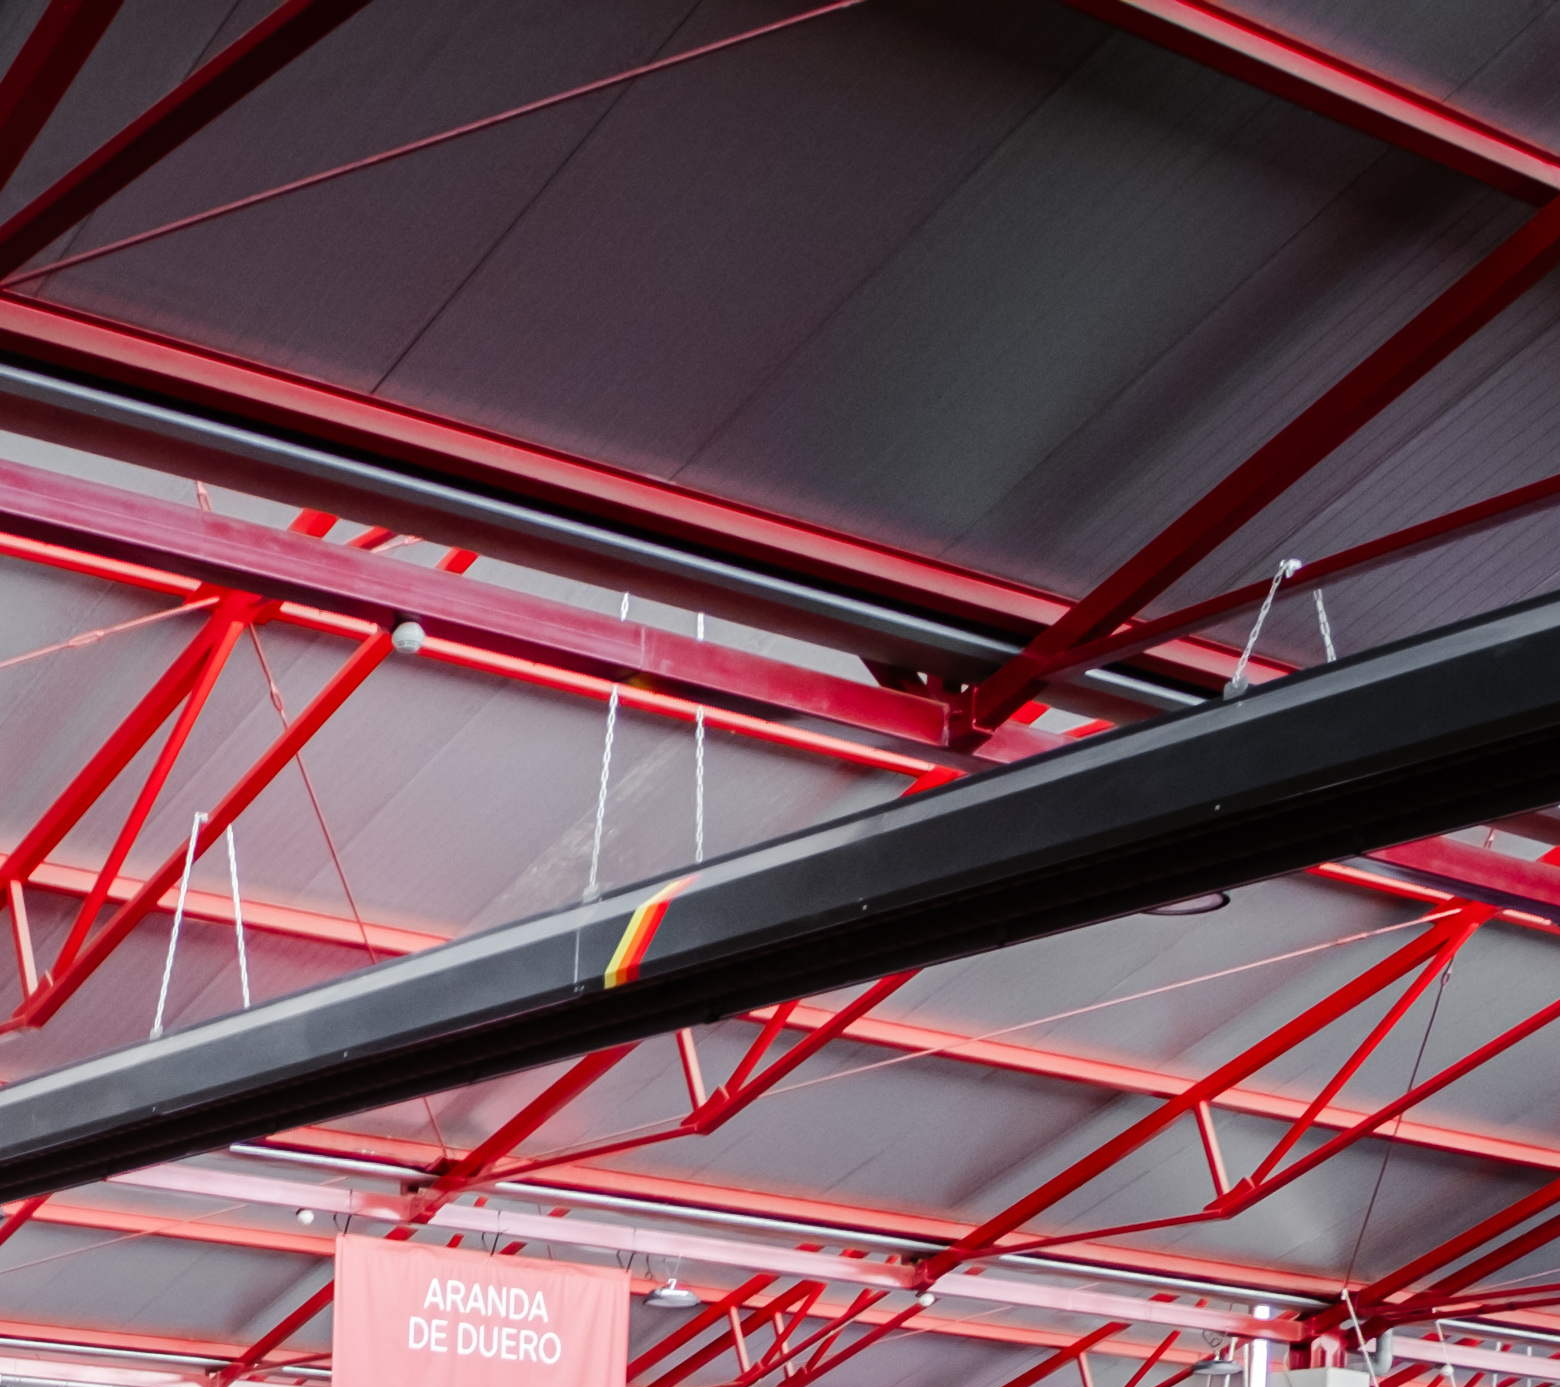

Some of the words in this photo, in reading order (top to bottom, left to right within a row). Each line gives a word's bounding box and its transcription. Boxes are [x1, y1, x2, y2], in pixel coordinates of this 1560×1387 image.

[423, 1278, 549, 1324] ARANDA
[408, 1315, 448, 1353] DE
[456, 1321, 562, 1365] DUERO
